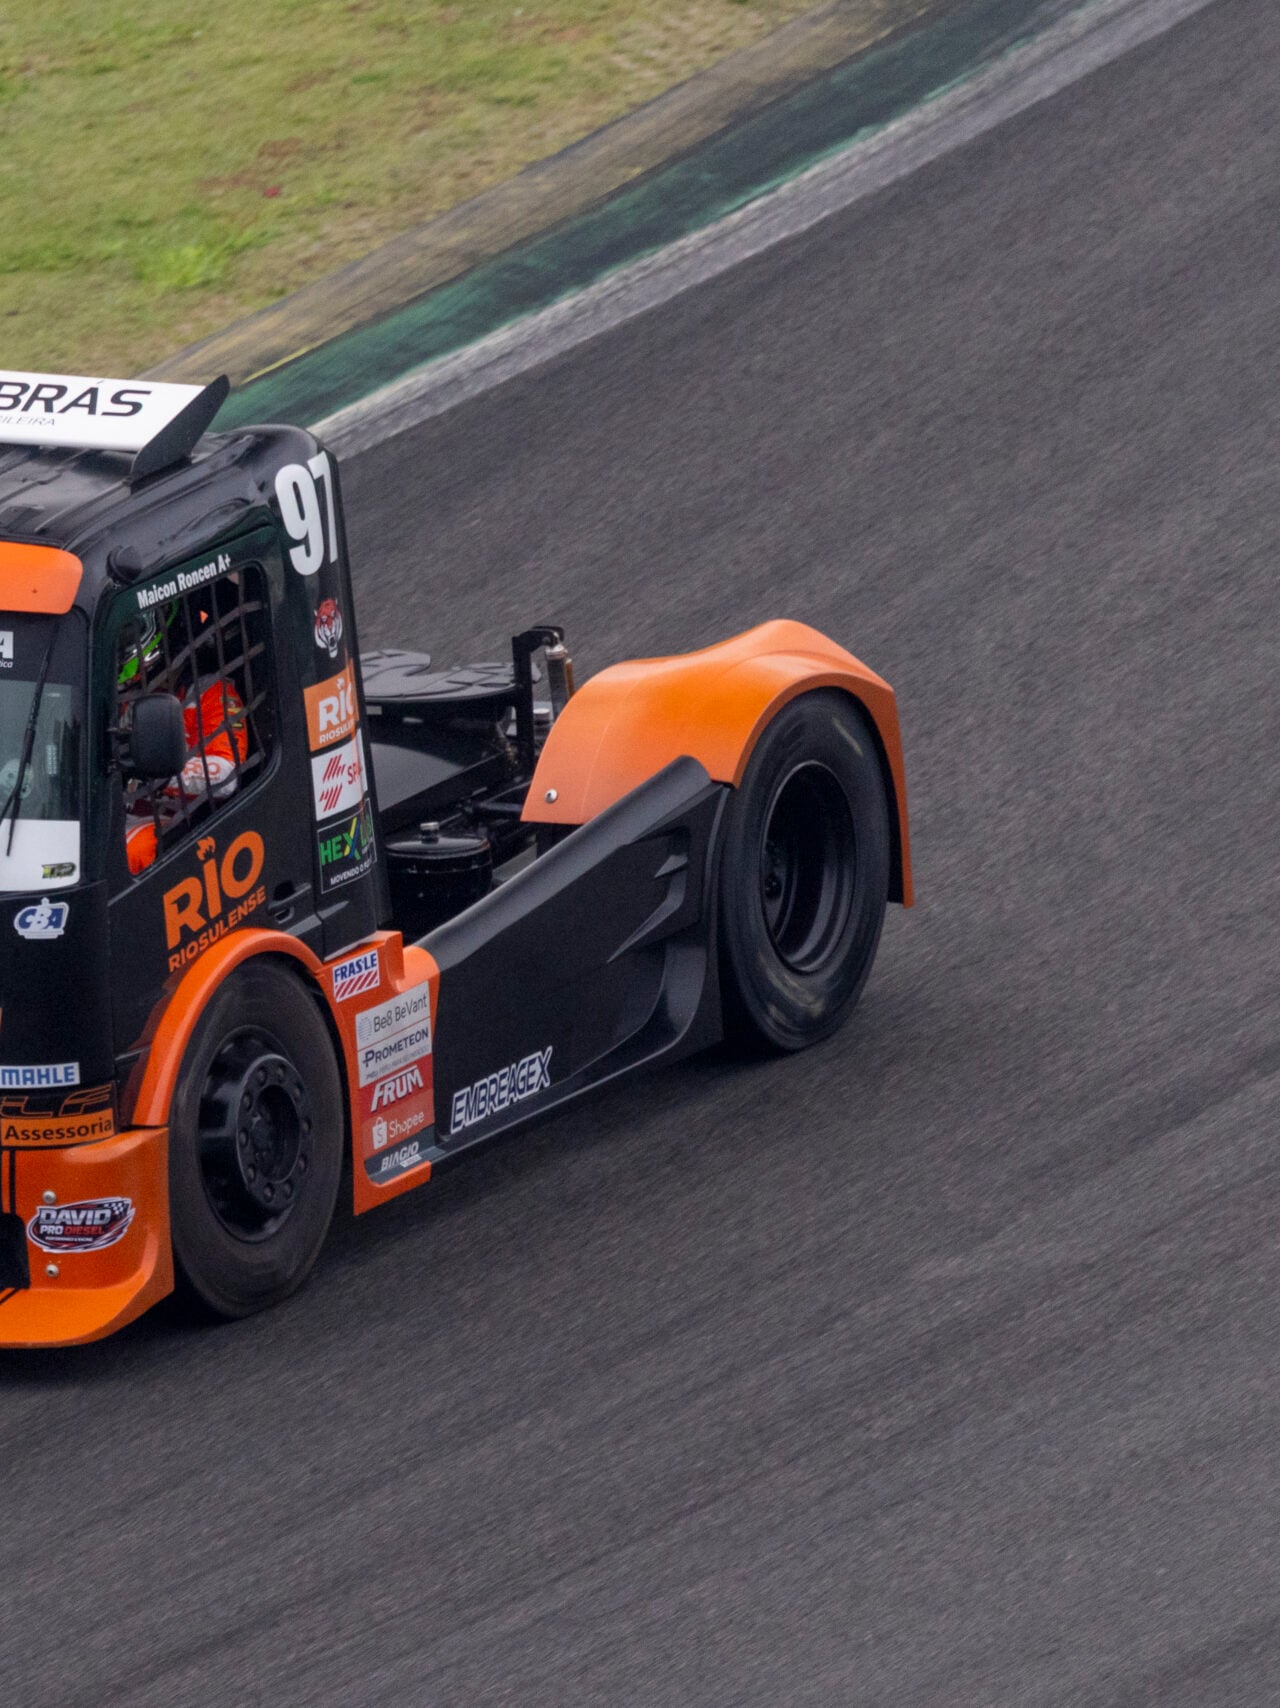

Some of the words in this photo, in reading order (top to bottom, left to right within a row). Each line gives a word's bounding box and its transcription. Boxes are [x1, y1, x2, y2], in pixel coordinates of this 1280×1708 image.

[275, 451, 338, 576] 97
[136, 584, 178, 609] Maicon
[177, 562, 217, 592] Roncen
[217, 553, 231, 574] A+
[163, 831, 265, 951] RIO
[168, 885, 266, 973] RIOSULENSE
[373, 1010, 393, 1033] Be8
[394, 993, 428, 1022] BeVant
[363, 1027, 429, 1068] PROMETEON
[1, 1065, 75, 1086] MAHLE
[370, 1064, 424, 1113] FRUM
[451, 1045, 553, 1135] EMBREAGEX
[4, 1117, 113, 1141] Assessoria
[389, 1111, 425, 1138] Shopee
[381, 1141, 419, 1172] BIAGIO
[39, 1208, 112, 1226] DAVID
[40, 1225, 64, 1235] PRO
[64, 1225, 104, 1235] DIESEL
